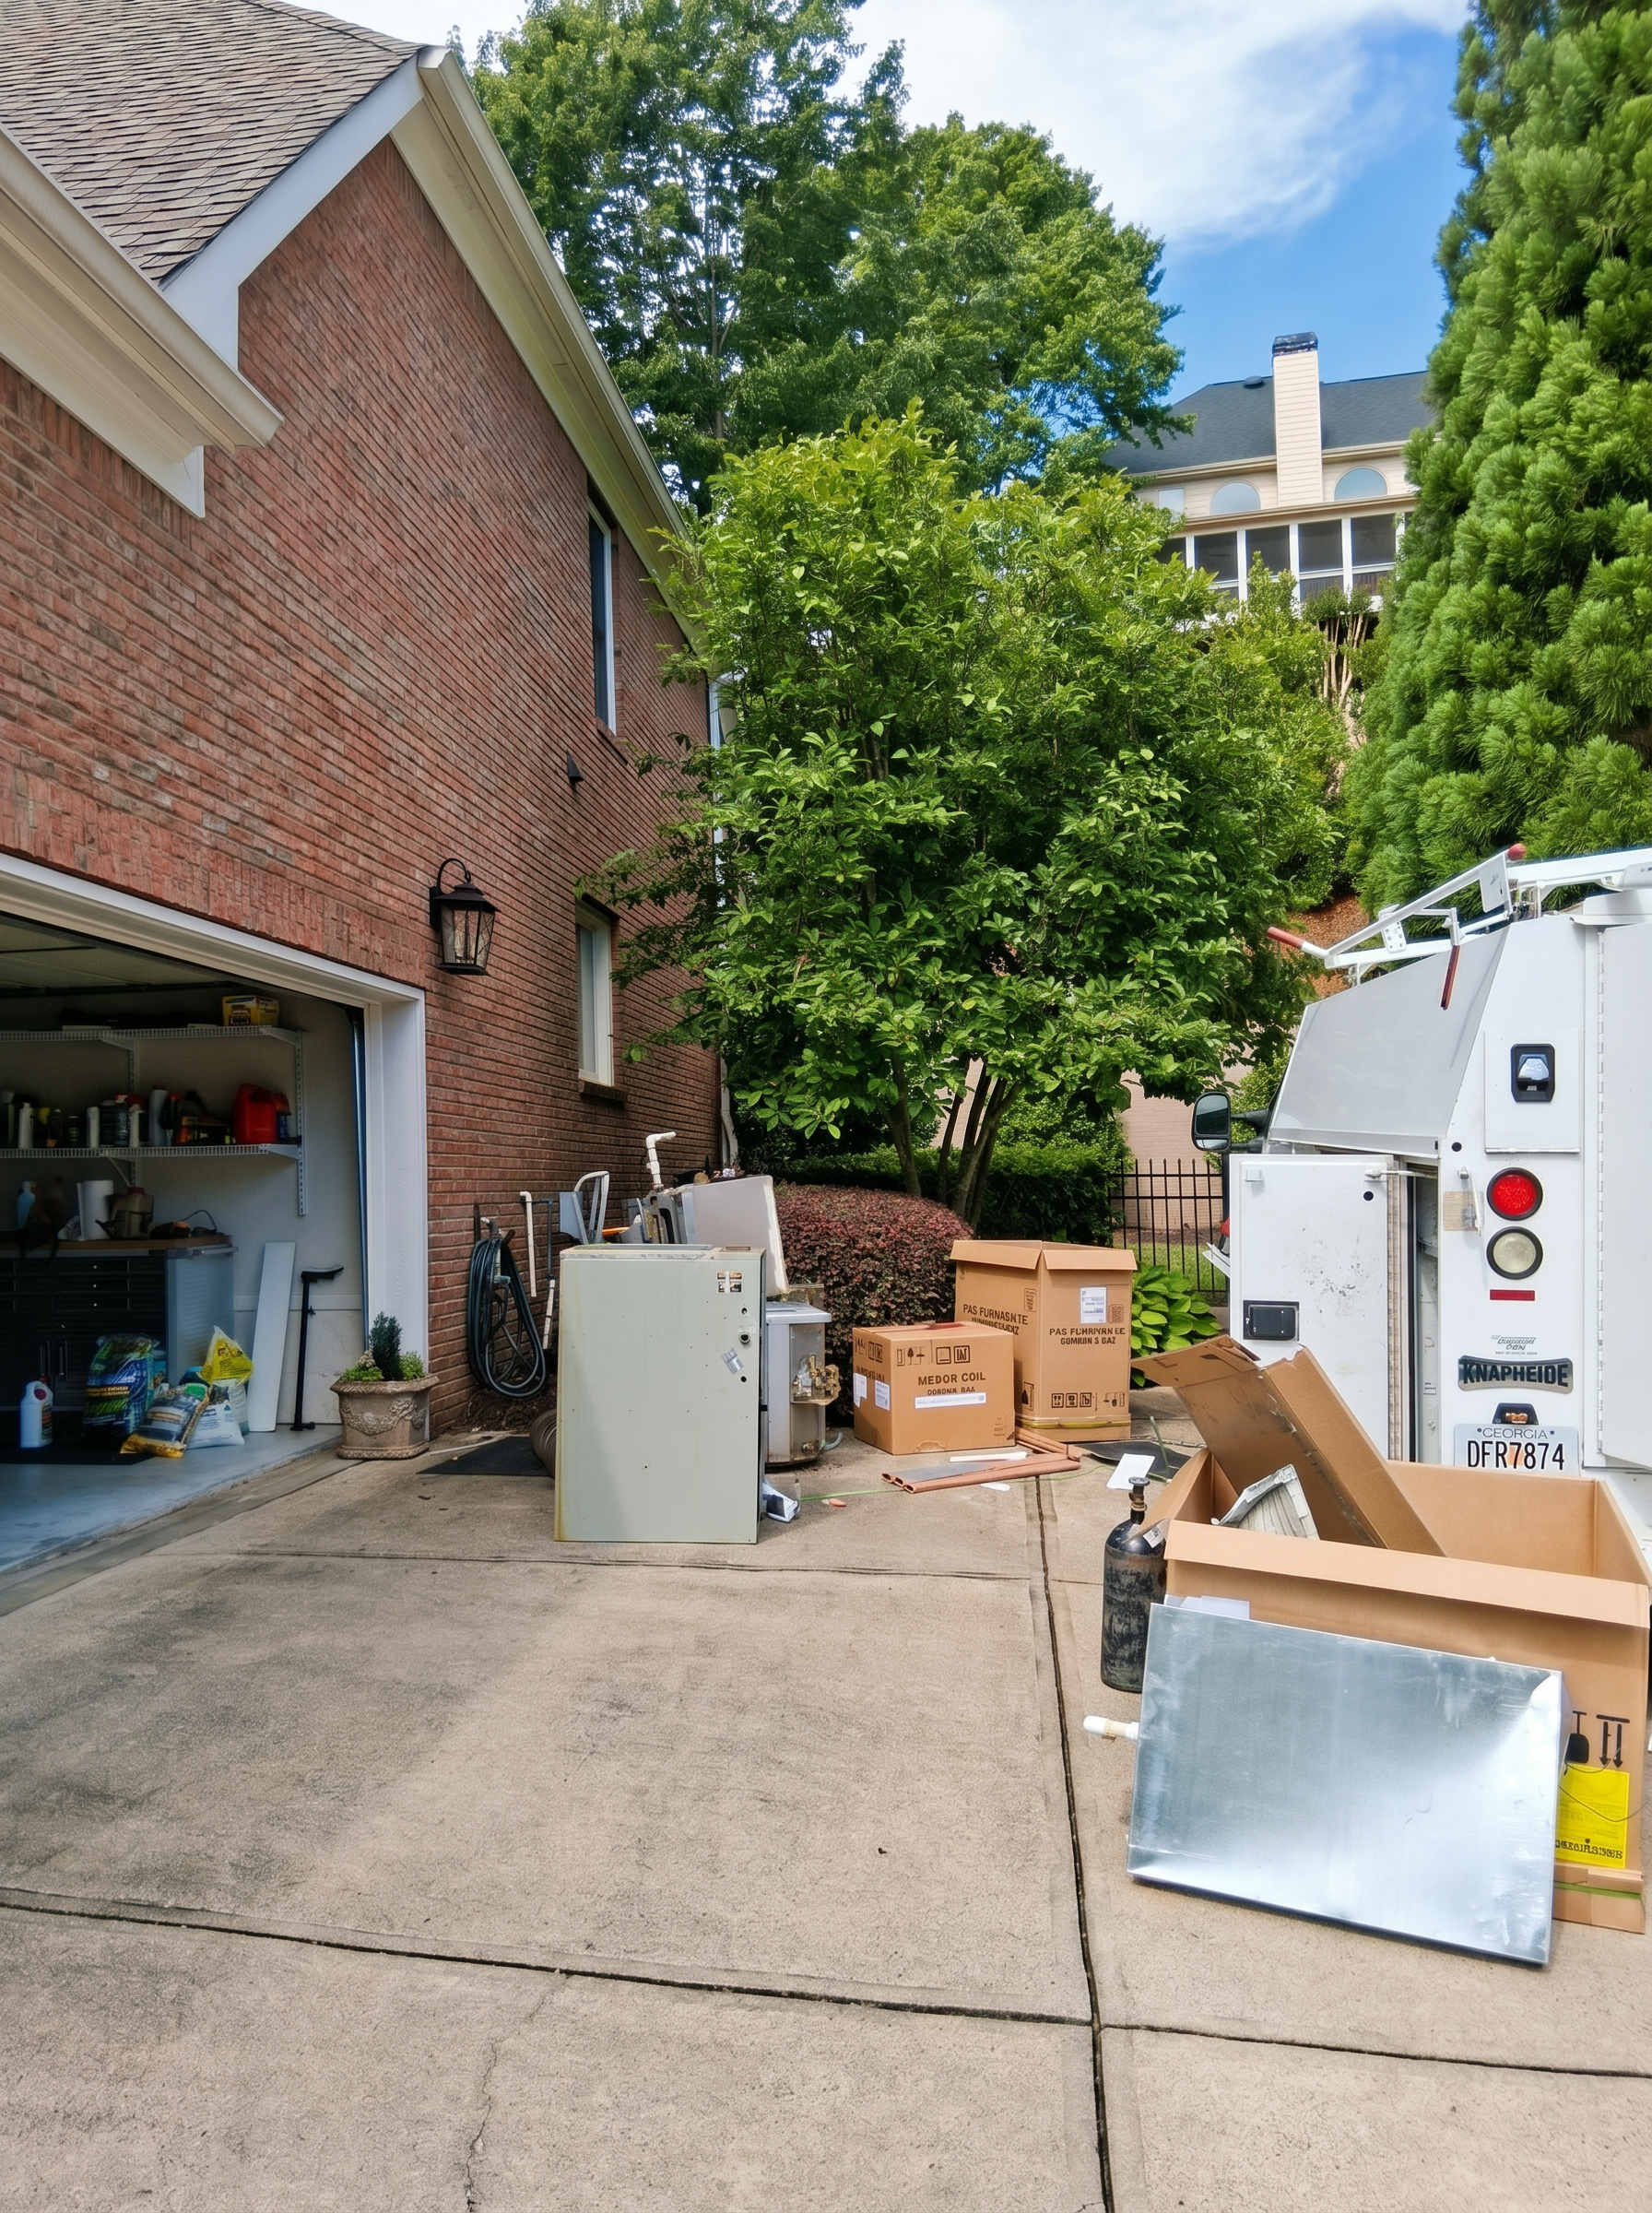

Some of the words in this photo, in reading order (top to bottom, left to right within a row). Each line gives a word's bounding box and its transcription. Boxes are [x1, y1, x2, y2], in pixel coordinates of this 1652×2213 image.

[963, 1304, 977, 1315] PAS
[918, 1374, 958, 1386] MEDOR
[962, 1372, 986, 1382] COIL
[1463, 1361, 1568, 1388] KNAPHEIDE
[1468, 1440, 1564, 1471] DFR7874
